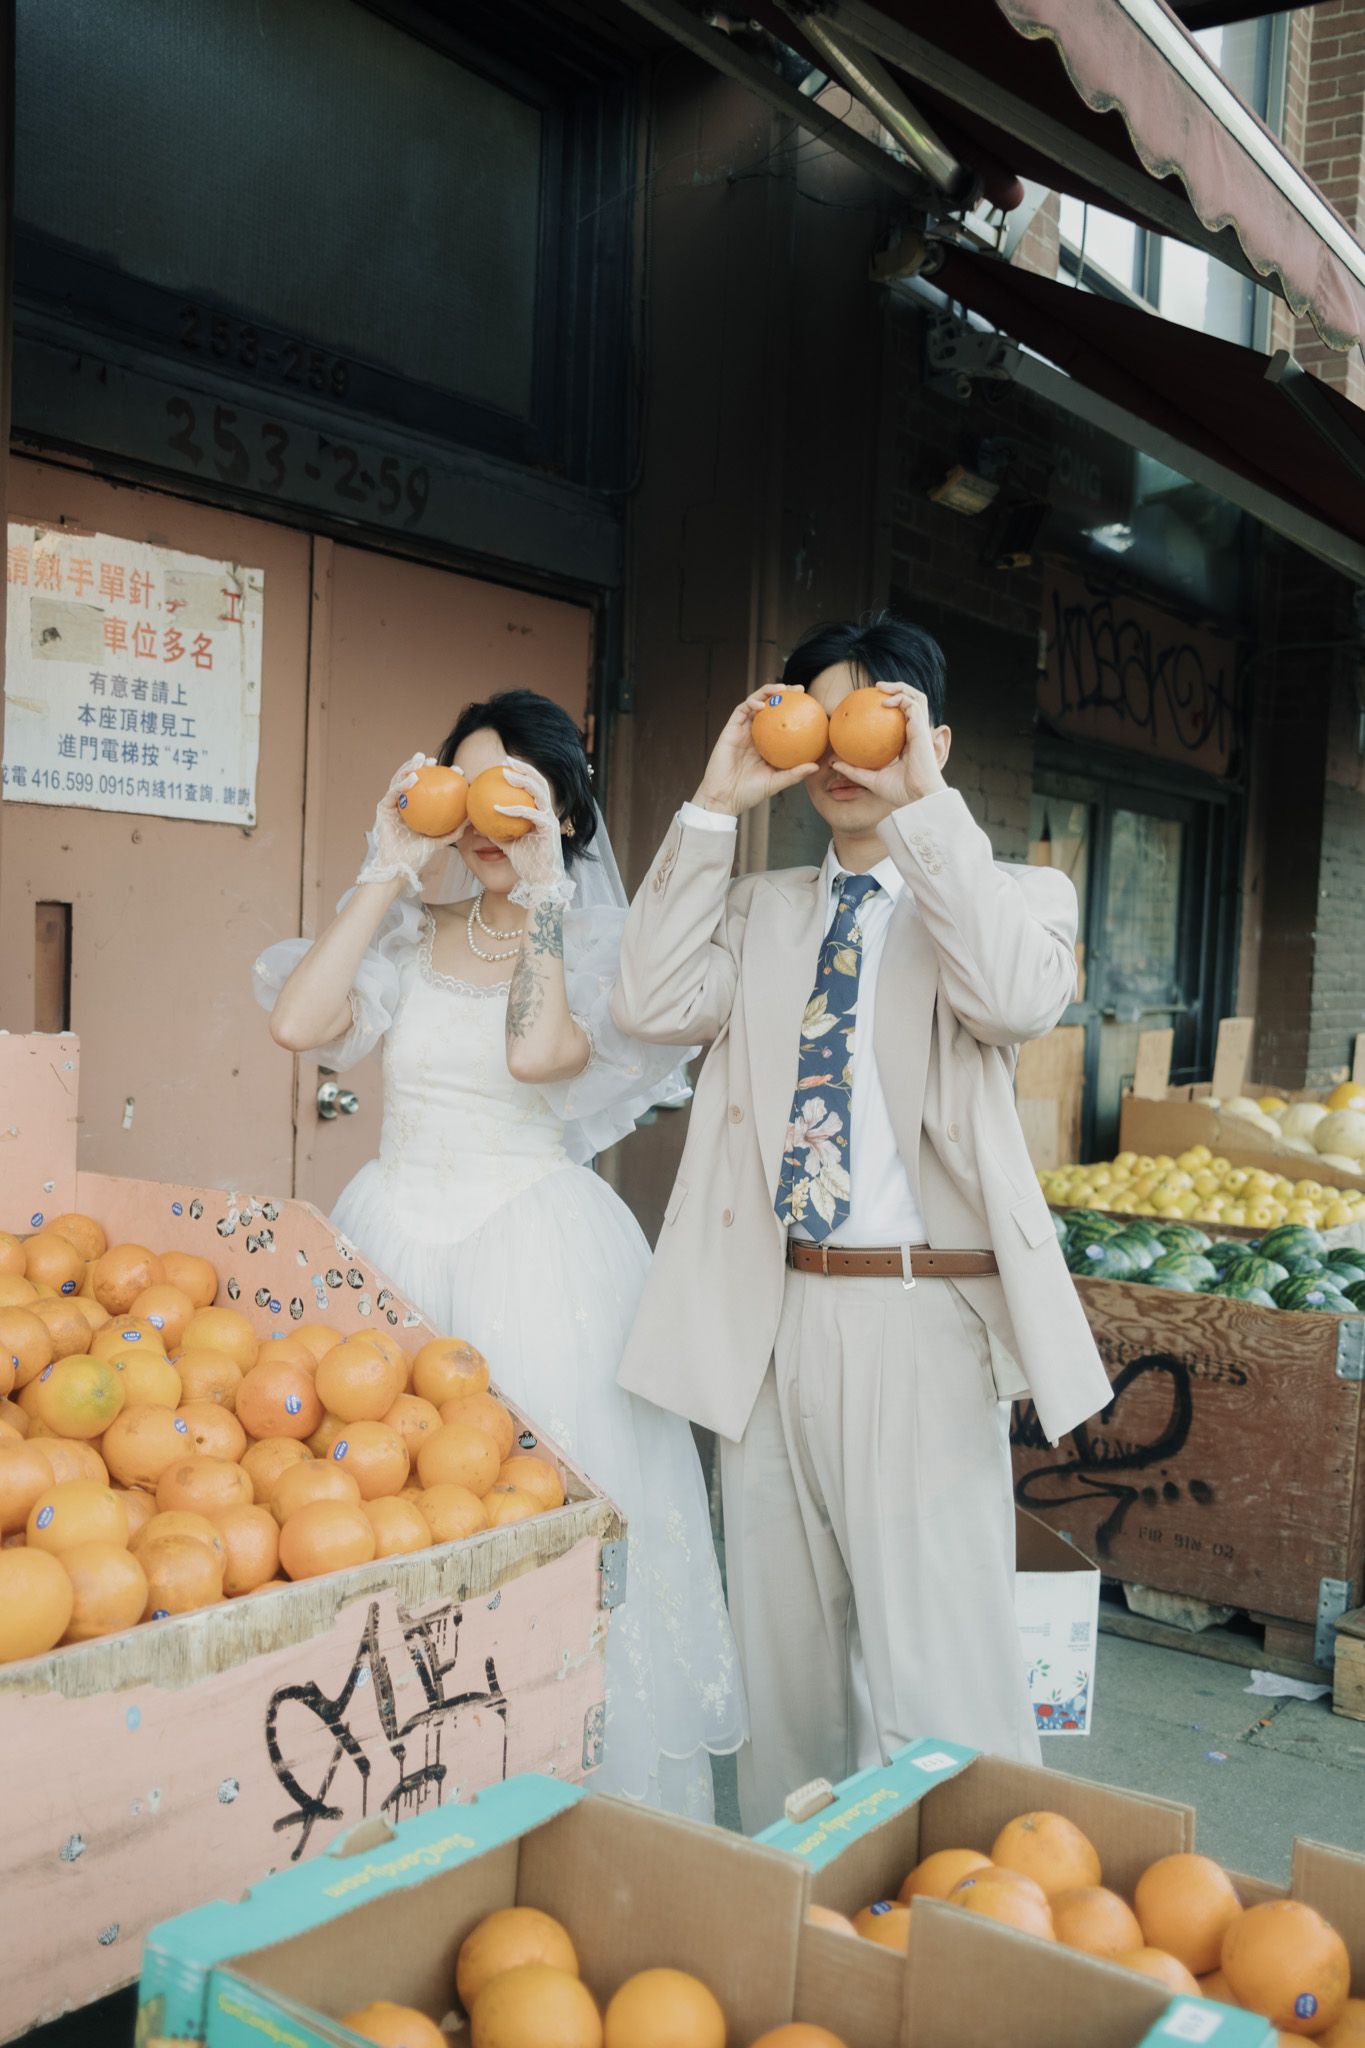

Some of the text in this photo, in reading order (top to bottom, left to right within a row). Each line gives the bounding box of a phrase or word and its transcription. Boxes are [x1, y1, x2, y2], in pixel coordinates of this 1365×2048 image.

[165, 395, 431, 529] 253-259
[89, 671, 188, 707] 有意者請上
[77, 702, 197, 739] 本座頂樓見工
